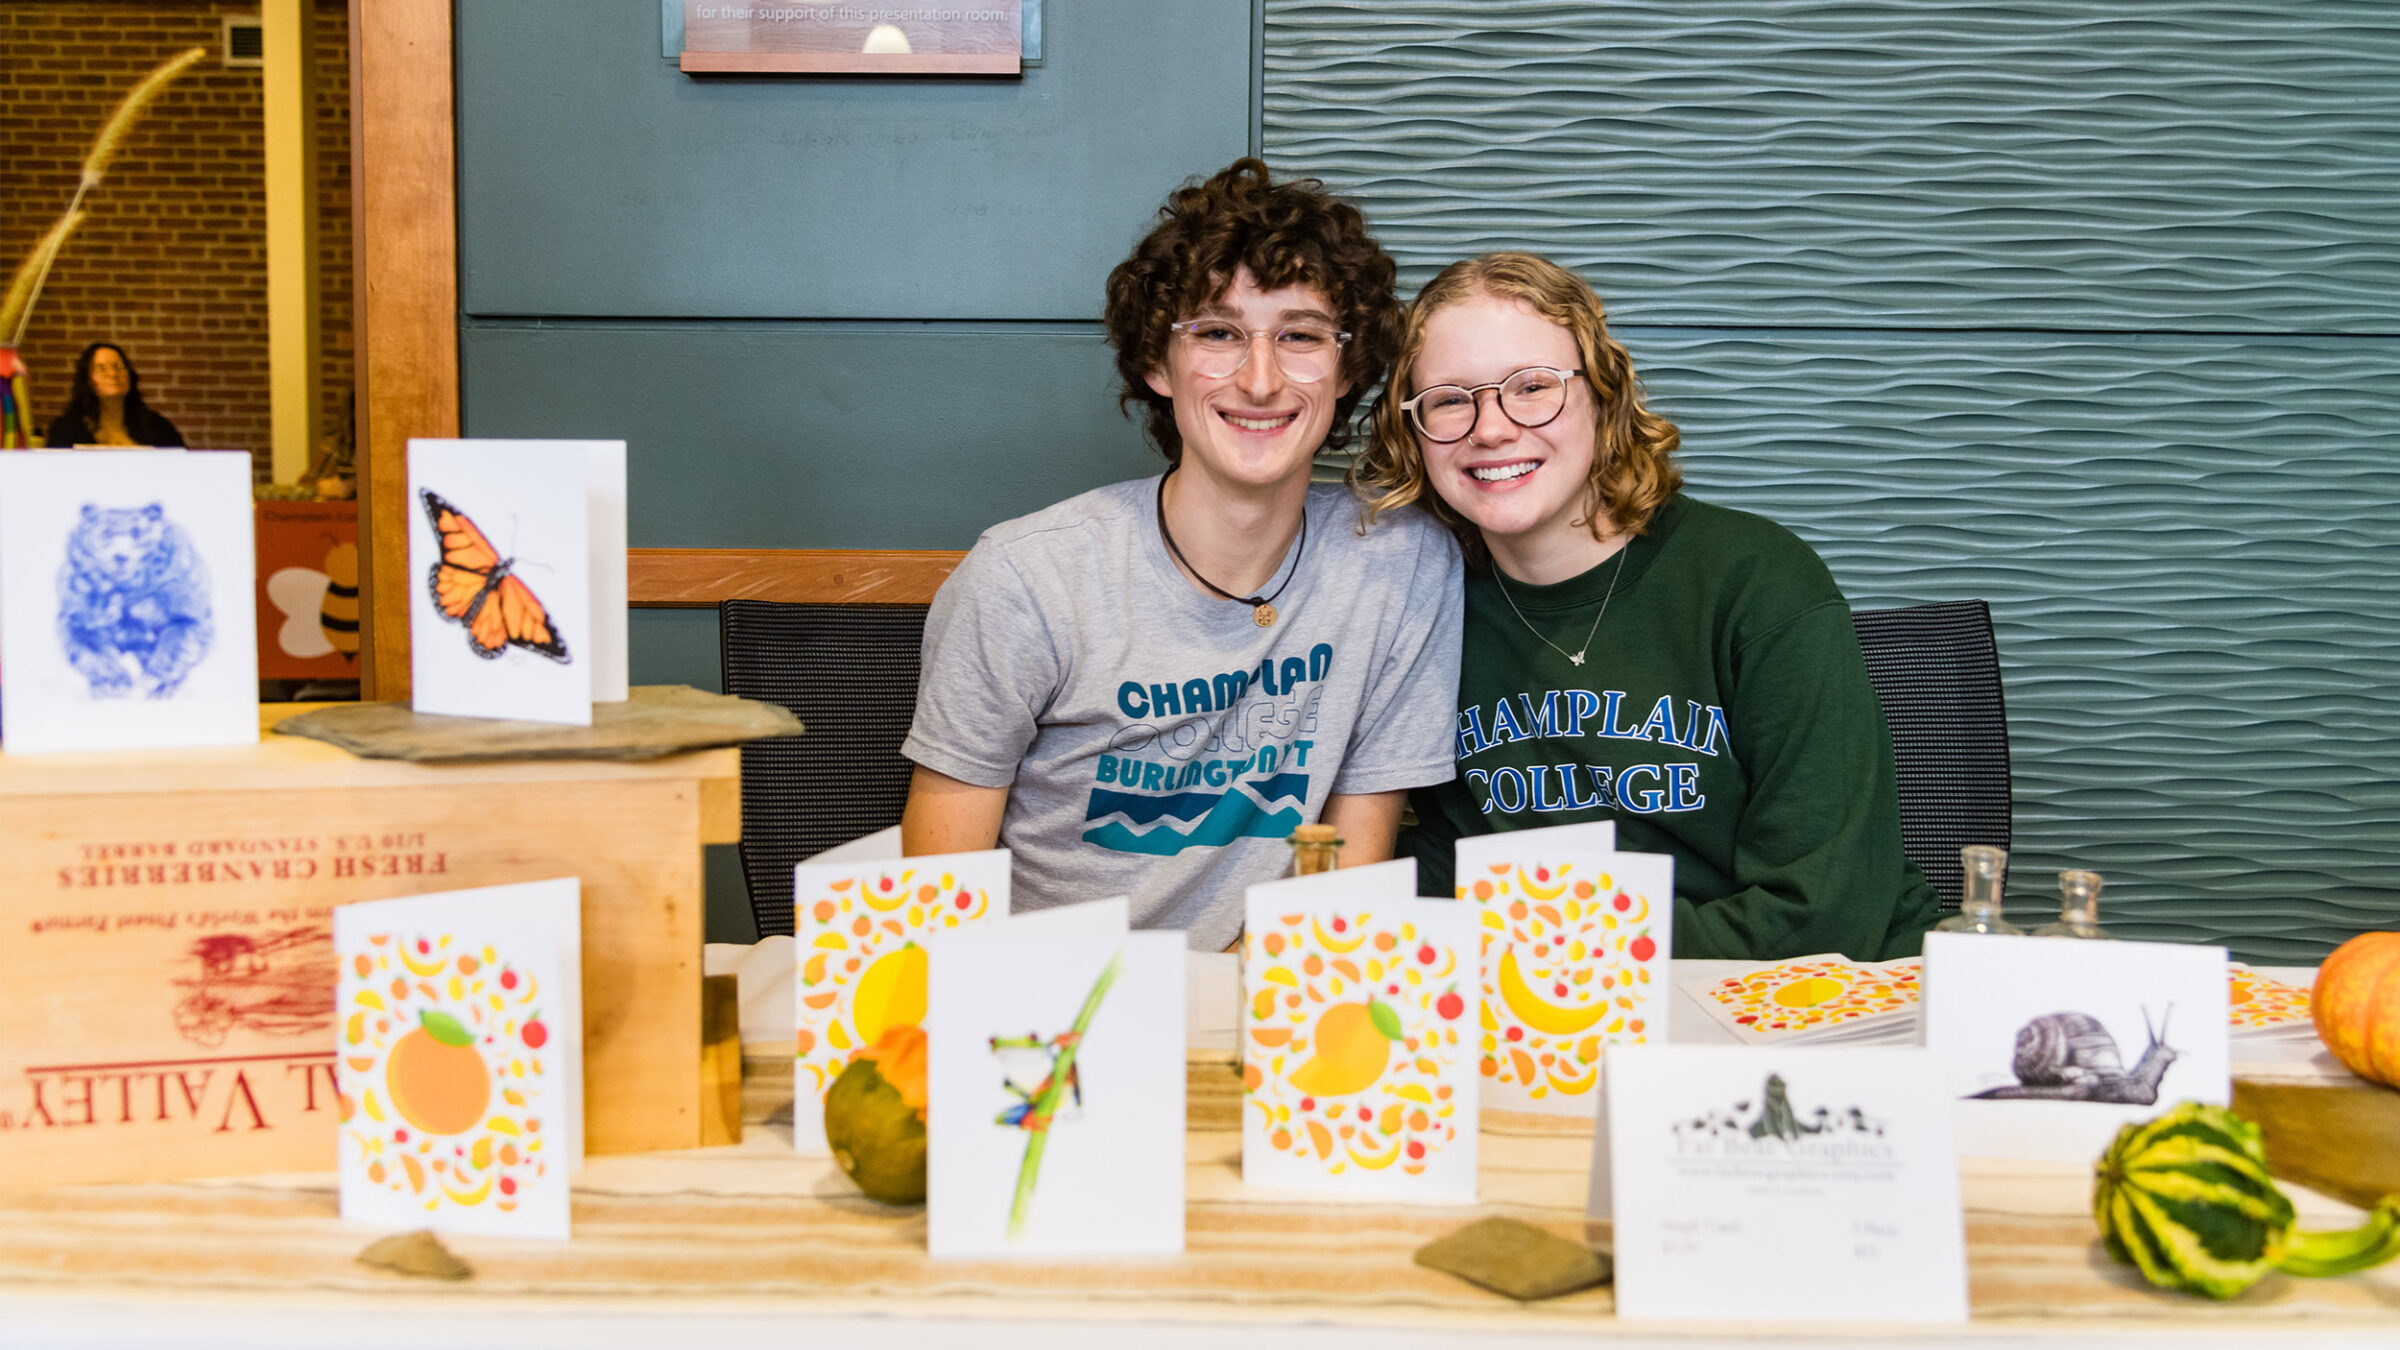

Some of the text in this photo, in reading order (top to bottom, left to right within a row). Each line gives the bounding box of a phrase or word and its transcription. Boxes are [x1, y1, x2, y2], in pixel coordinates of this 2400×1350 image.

[696, 4, 1008, 22] for their support of this presentation room.
[1455, 690, 1732, 759] HAMPLAIN
[1465, 763, 1705, 814] COLLEGE
[186, 837, 319, 856] STANDARD
[56, 852, 449, 889] FRESH CRANBERRIES
